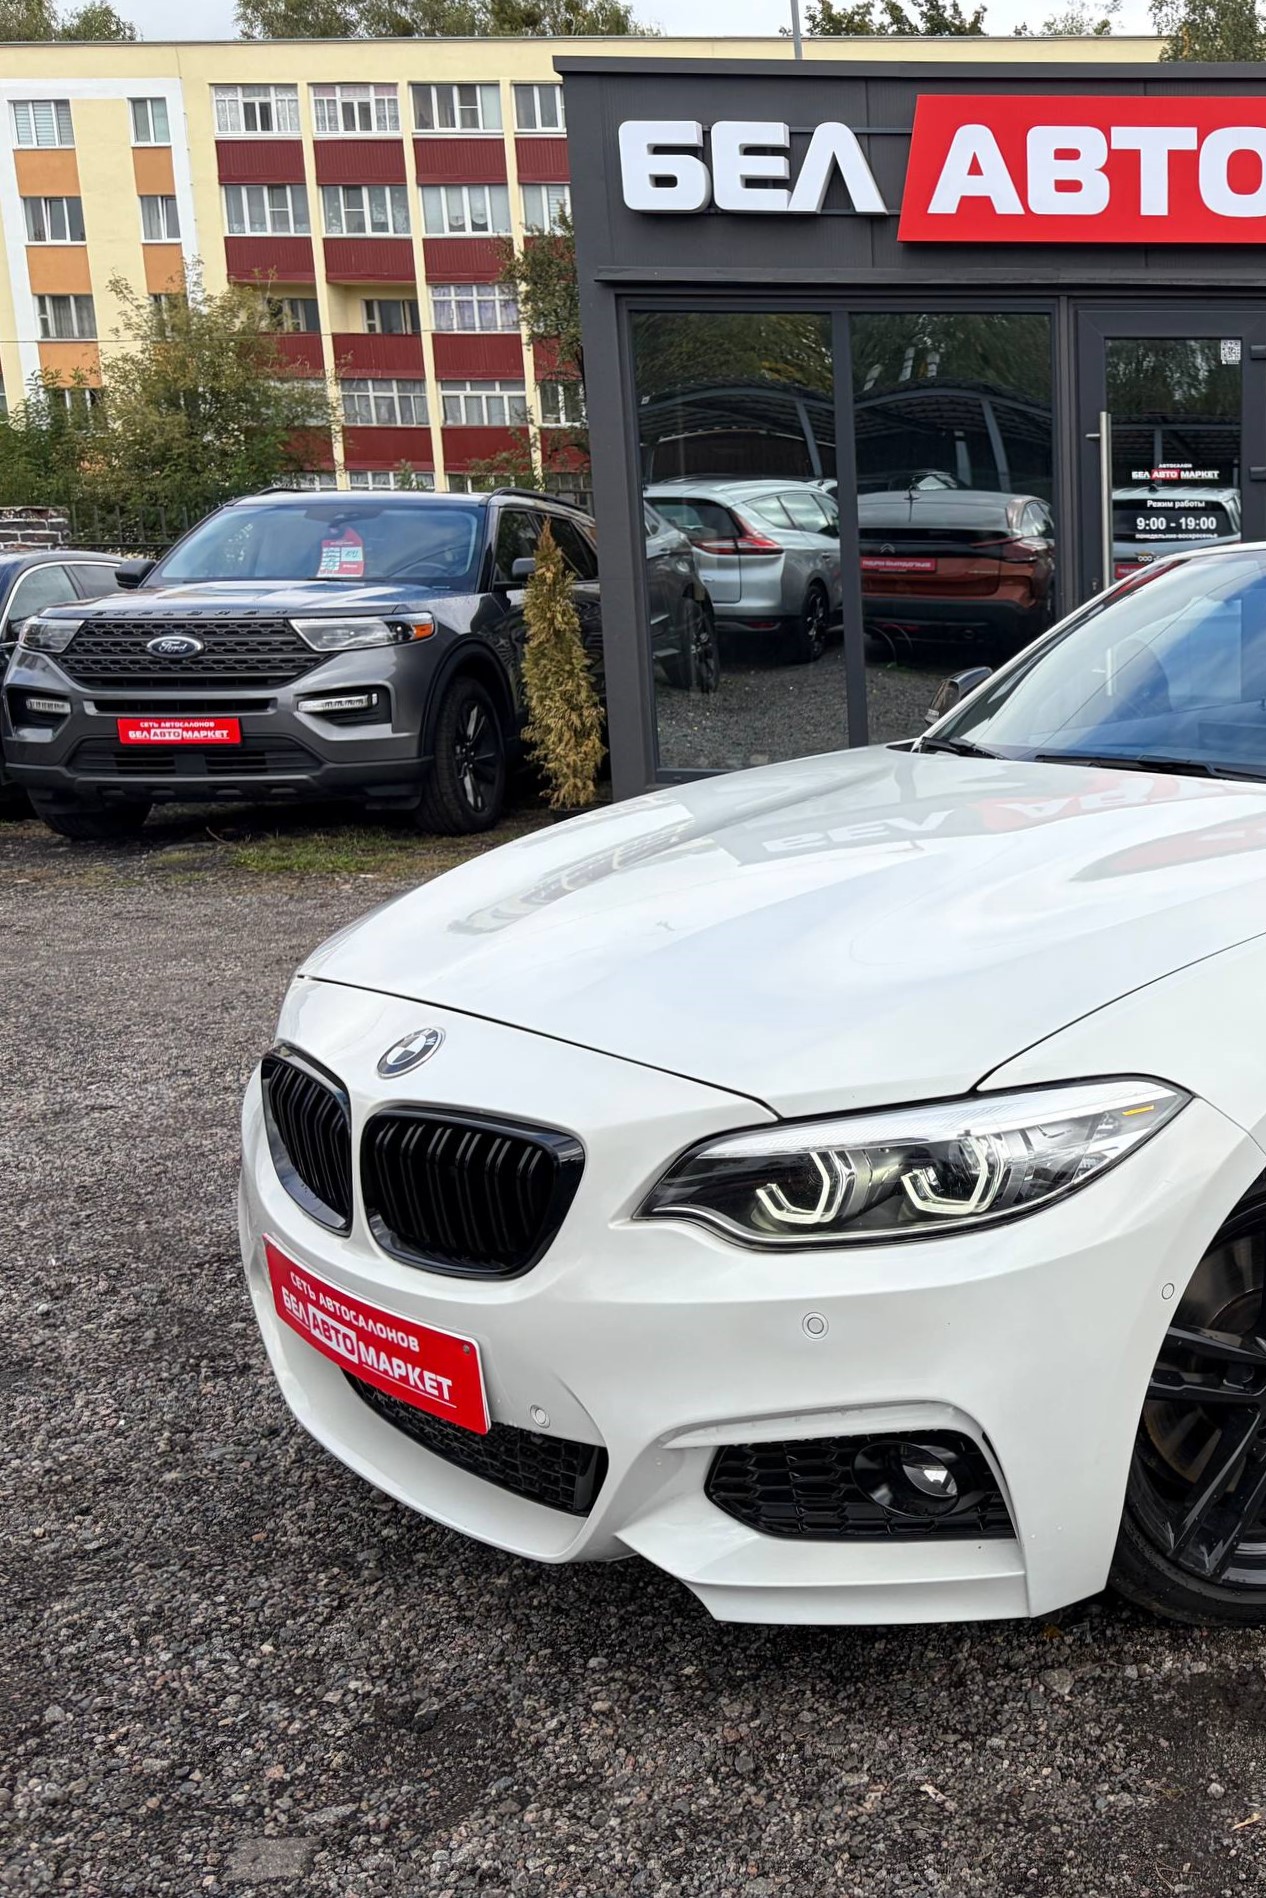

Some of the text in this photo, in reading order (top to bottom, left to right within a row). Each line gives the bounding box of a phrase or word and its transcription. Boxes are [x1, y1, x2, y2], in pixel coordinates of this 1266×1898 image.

[618, 120, 888, 215] БЕЛ
[1131, 471, 1219, 479] БЕЛ АВТО МАРКЕТ
[1175, 500, 1205, 508] работы
[1136, 517, 1166, 530] 9:00
[1179, 517, 1217, 530] 19:00
[159, 641, 188, 653] Ford
[128, 730, 229, 739] БЕЛ АВТО МАРКЕТ
[290, 1271, 420, 1352] СЕТЬ АВТОСАЛОНОВ
[281, 1286, 452, 1401] БЕЛ АВТО МАРКЕТ
